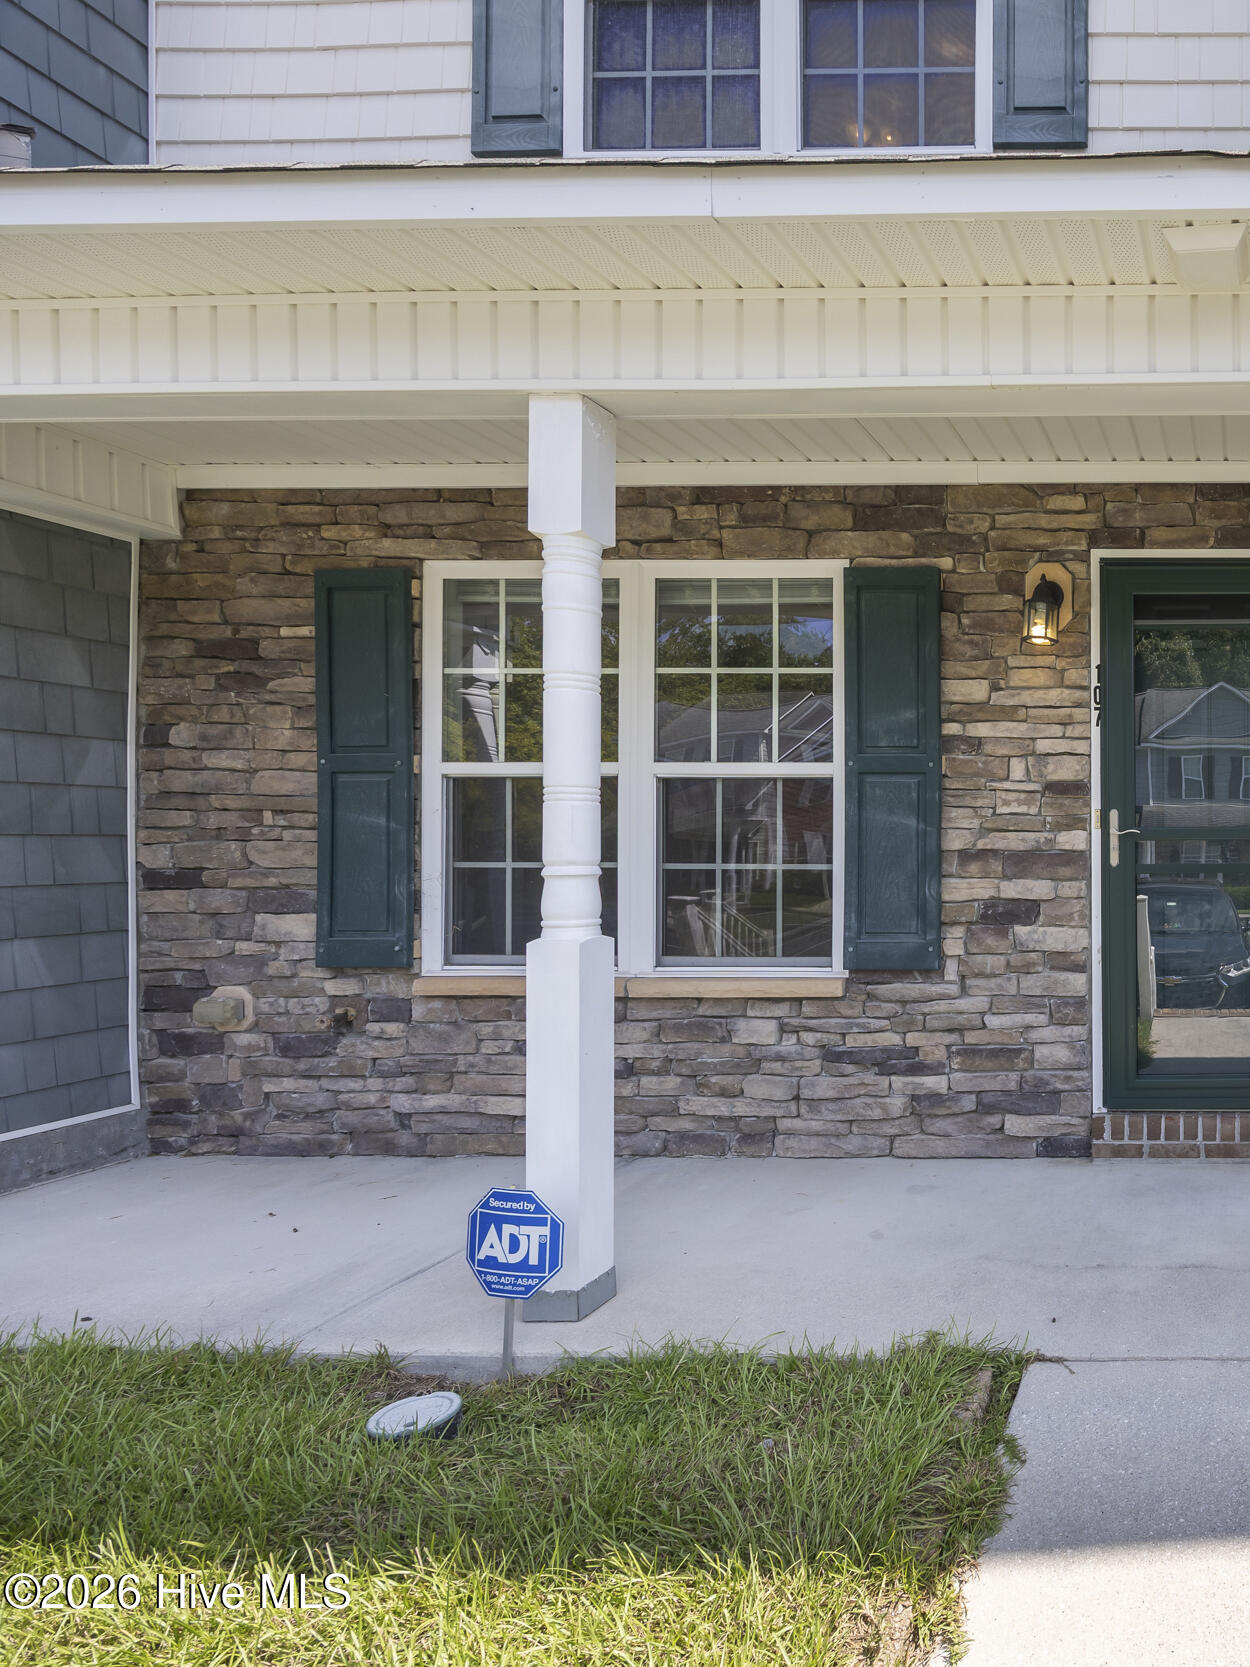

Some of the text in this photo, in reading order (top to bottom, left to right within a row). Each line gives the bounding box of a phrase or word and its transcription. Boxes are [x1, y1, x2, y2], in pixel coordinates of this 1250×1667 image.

[489, 1197, 536, 1212] Secured by
[481, 1274, 539, 1286] 1-800-ADT-ASAP
